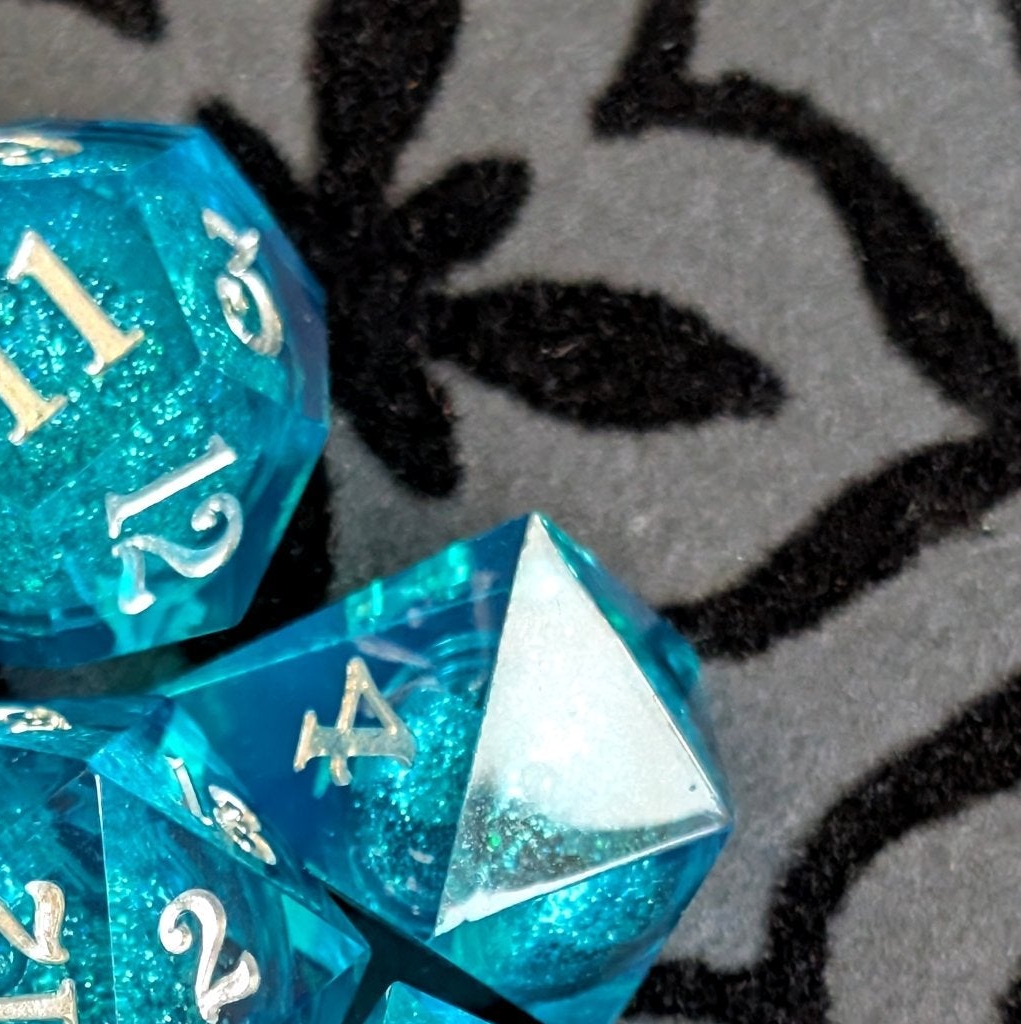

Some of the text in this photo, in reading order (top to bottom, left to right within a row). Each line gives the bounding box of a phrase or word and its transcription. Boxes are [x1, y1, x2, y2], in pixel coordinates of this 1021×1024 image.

[104, 434, 245, 614] 12
[293, 656, 417, 787] 4
[158, 888, 261, 1024] 2
